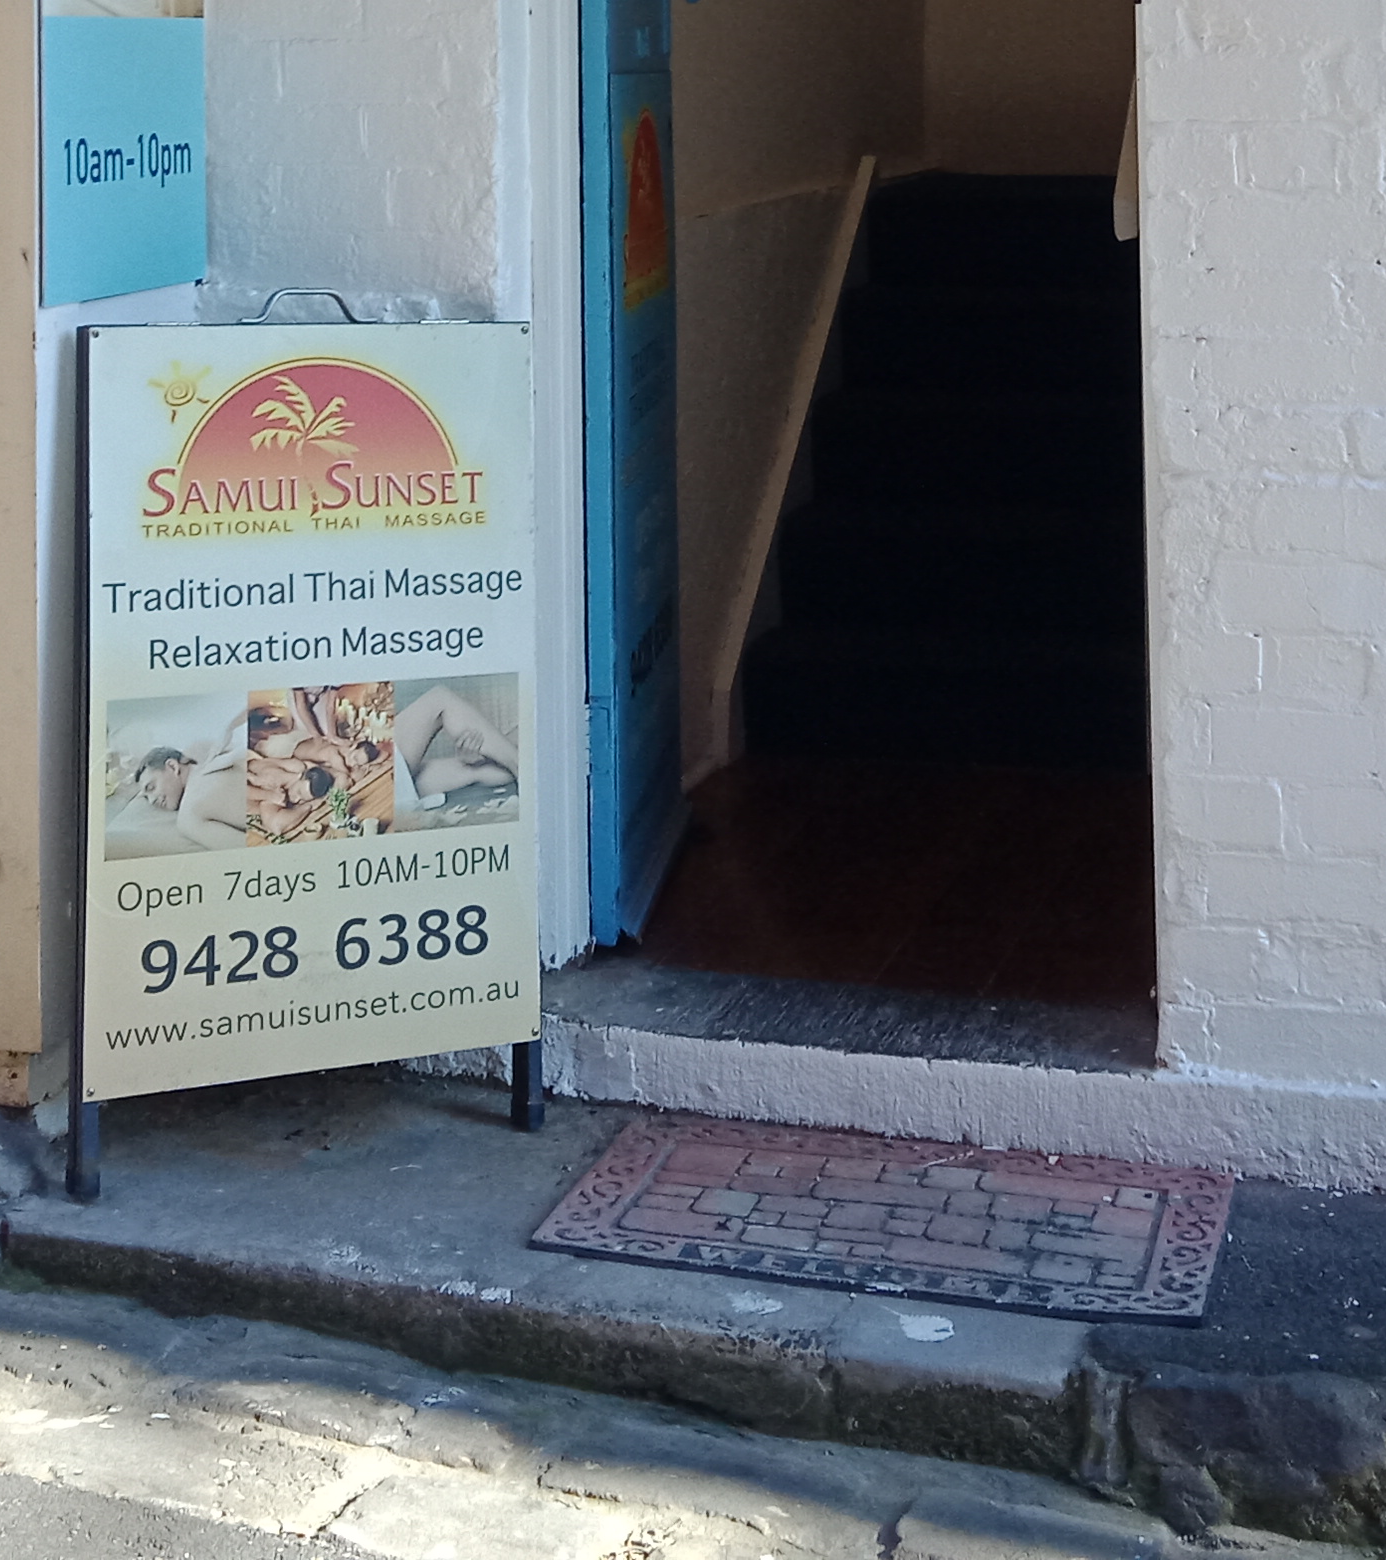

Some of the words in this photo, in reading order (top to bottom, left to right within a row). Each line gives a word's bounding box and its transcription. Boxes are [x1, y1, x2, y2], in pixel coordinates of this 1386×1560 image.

[63, 133, 192, 188] 10am-10pm
[142, 466, 299, 517] SAMUI
[323, 460, 484, 511] SUNSET
[141, 518, 294, 539] TRADITIONAL
[311, 515, 361, 532] THAI
[384, 509, 487, 529] MASSAGE
[102, 572, 295, 614] Traditional
[304, 569, 376, 604] Thai
[385, 566, 524, 601] Massage
[149, 632, 332, 670] Relaxation
[342, 621, 485, 658] Massage
[116, 878, 205, 917] Open
[223, 867, 317, 907] 7days
[336, 844, 511, 890] 10AM-10PM
[140, 925, 300, 995] 9428
[335, 905, 490, 971] 6388
[105, 978, 521, 1051] www.samuisunset.com.au
